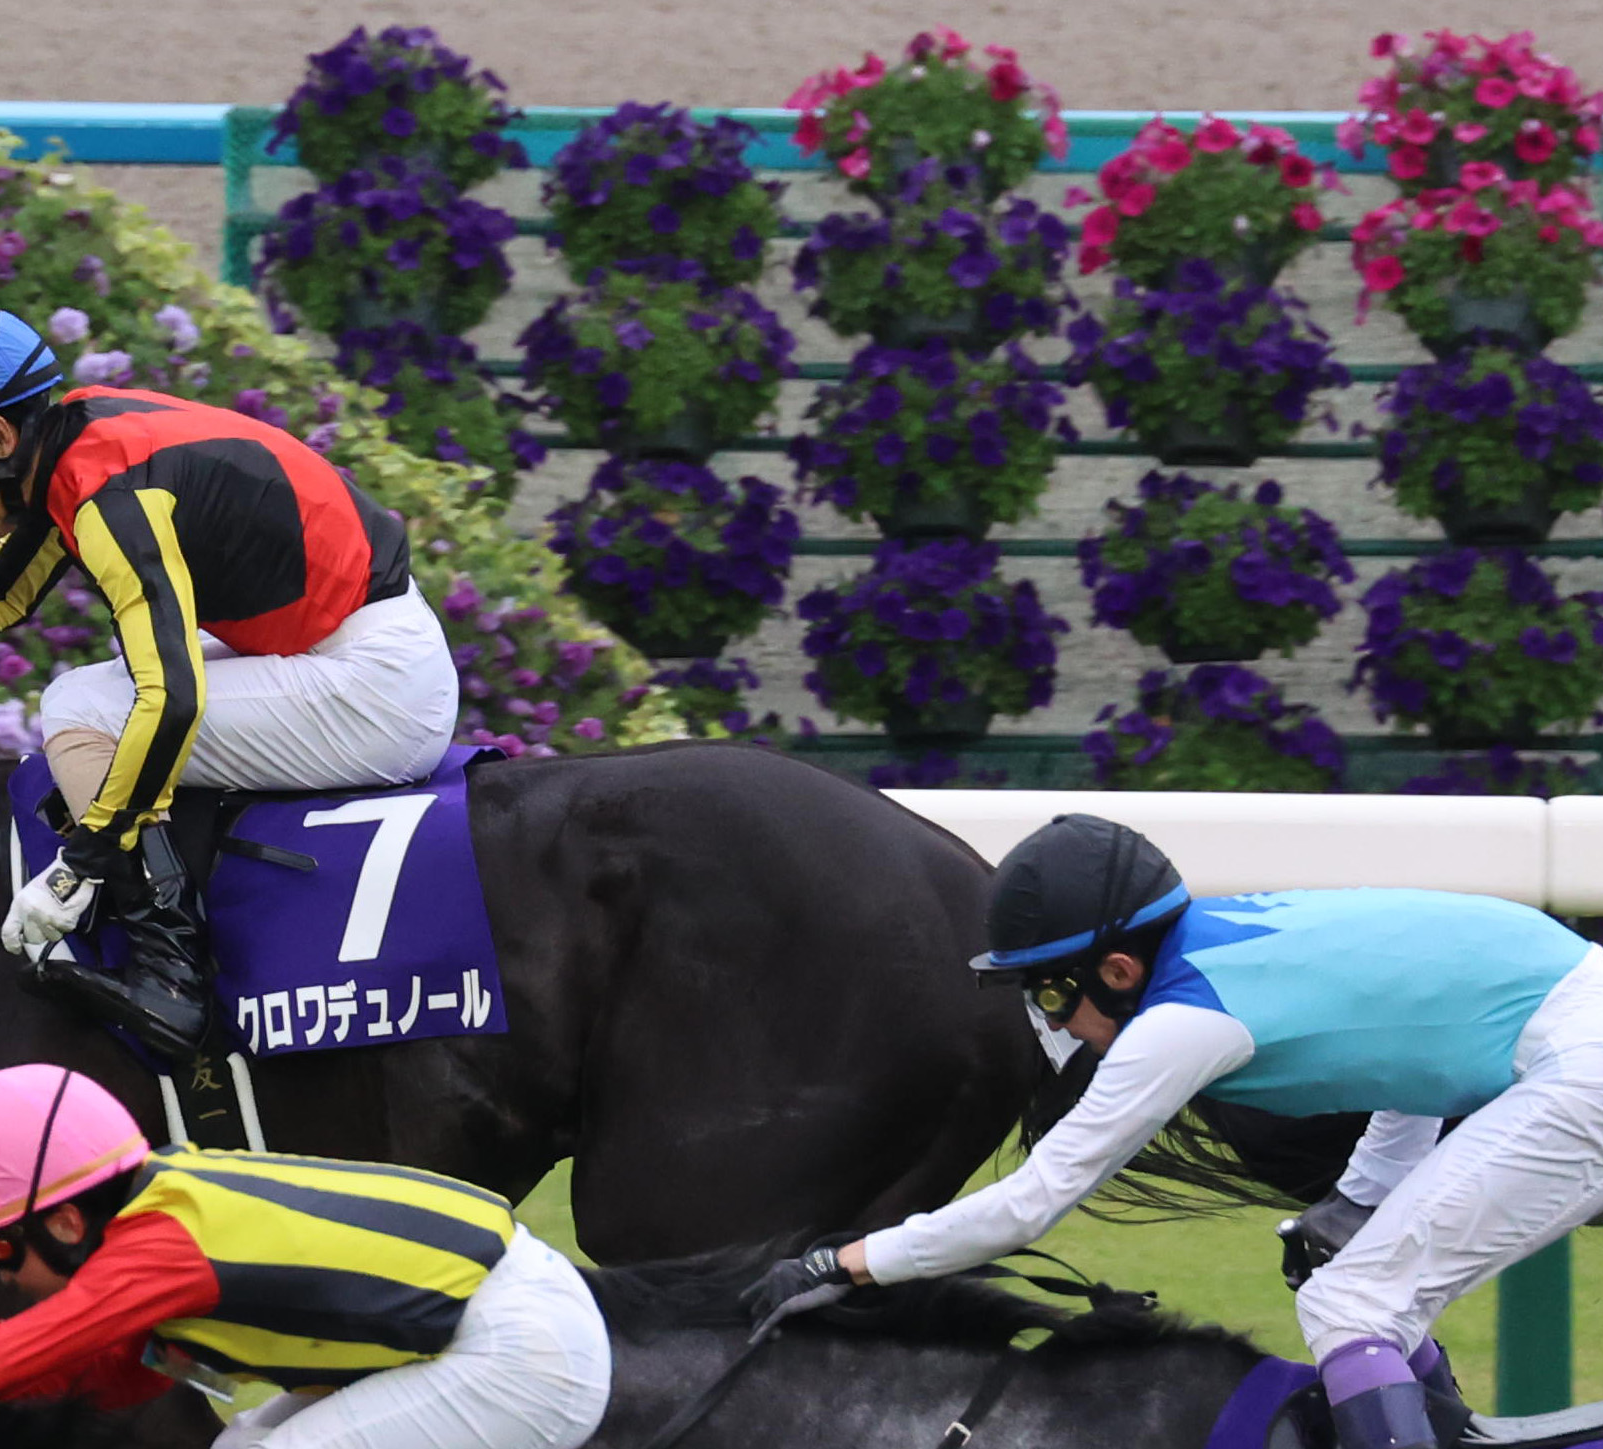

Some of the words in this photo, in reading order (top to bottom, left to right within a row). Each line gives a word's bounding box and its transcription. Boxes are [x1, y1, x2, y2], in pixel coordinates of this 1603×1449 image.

[302, 793, 439, 963] 7
[237, 968, 492, 1055] クロワデュノール
